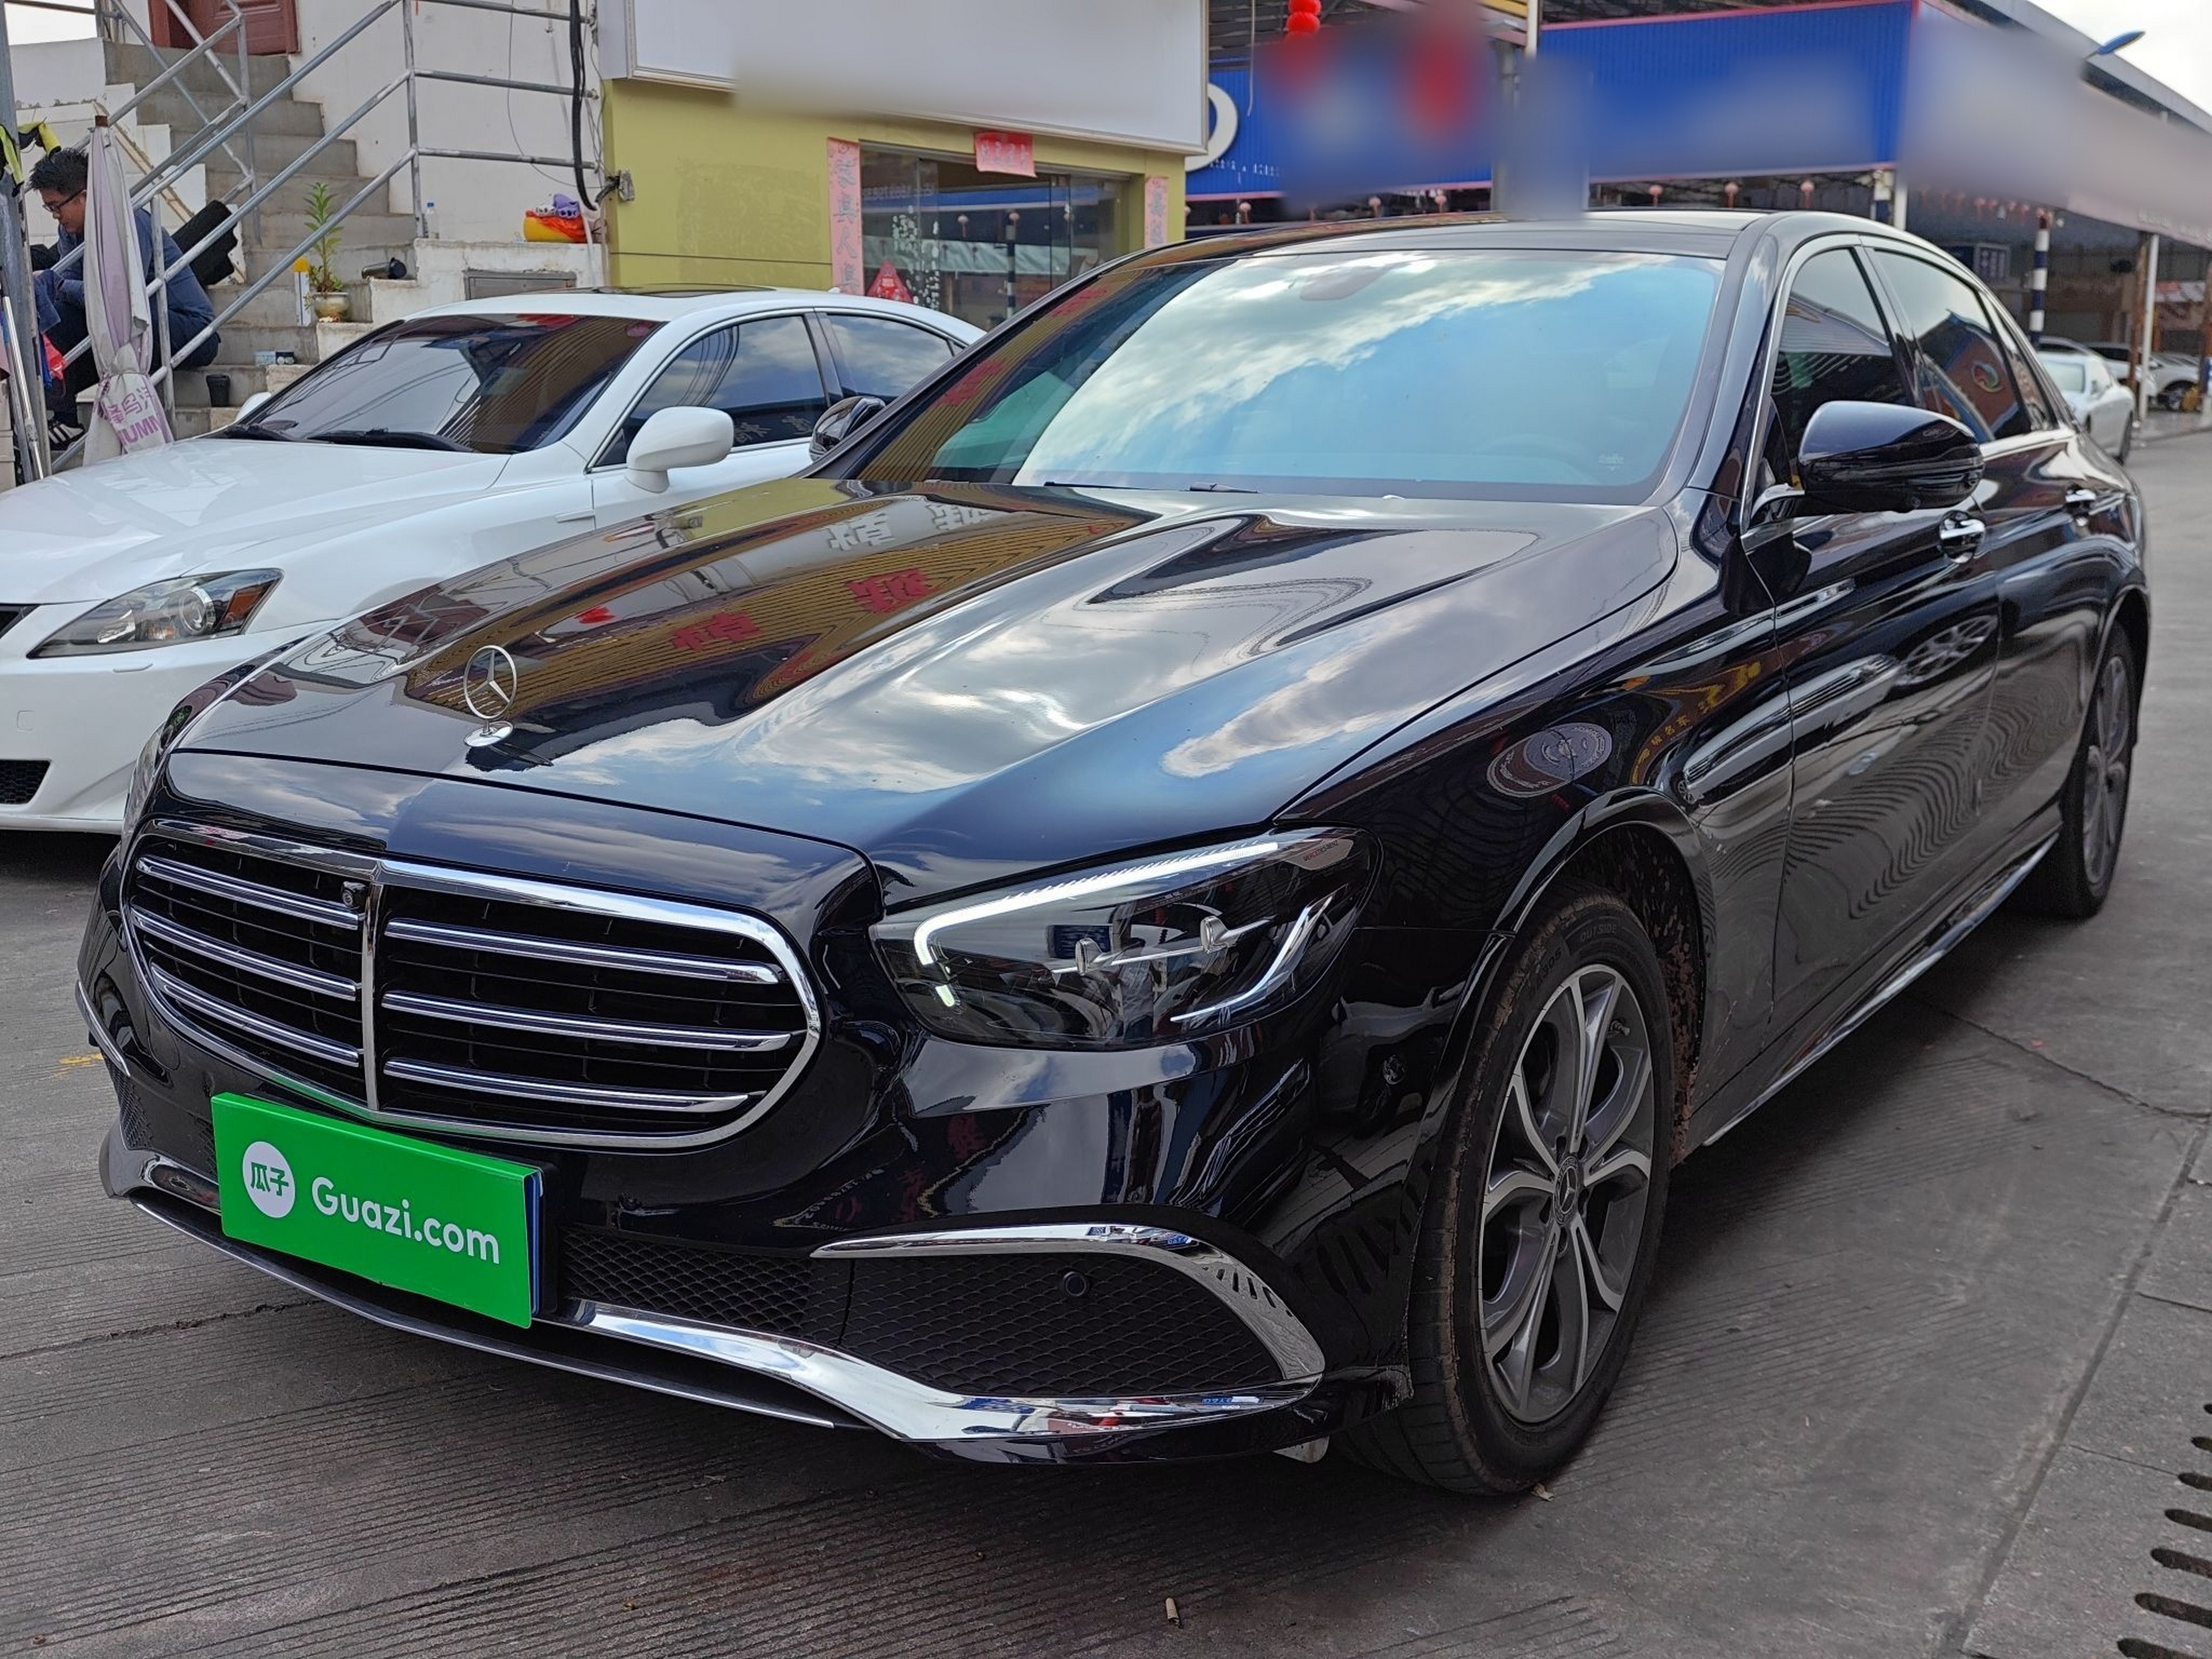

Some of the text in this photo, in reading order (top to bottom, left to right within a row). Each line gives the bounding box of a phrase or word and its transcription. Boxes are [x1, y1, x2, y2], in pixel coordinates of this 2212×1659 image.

[1580, 923, 1617, 942] OUTSIDE
[251, 1162, 500, 1264] 瓜子 Guazi.com
